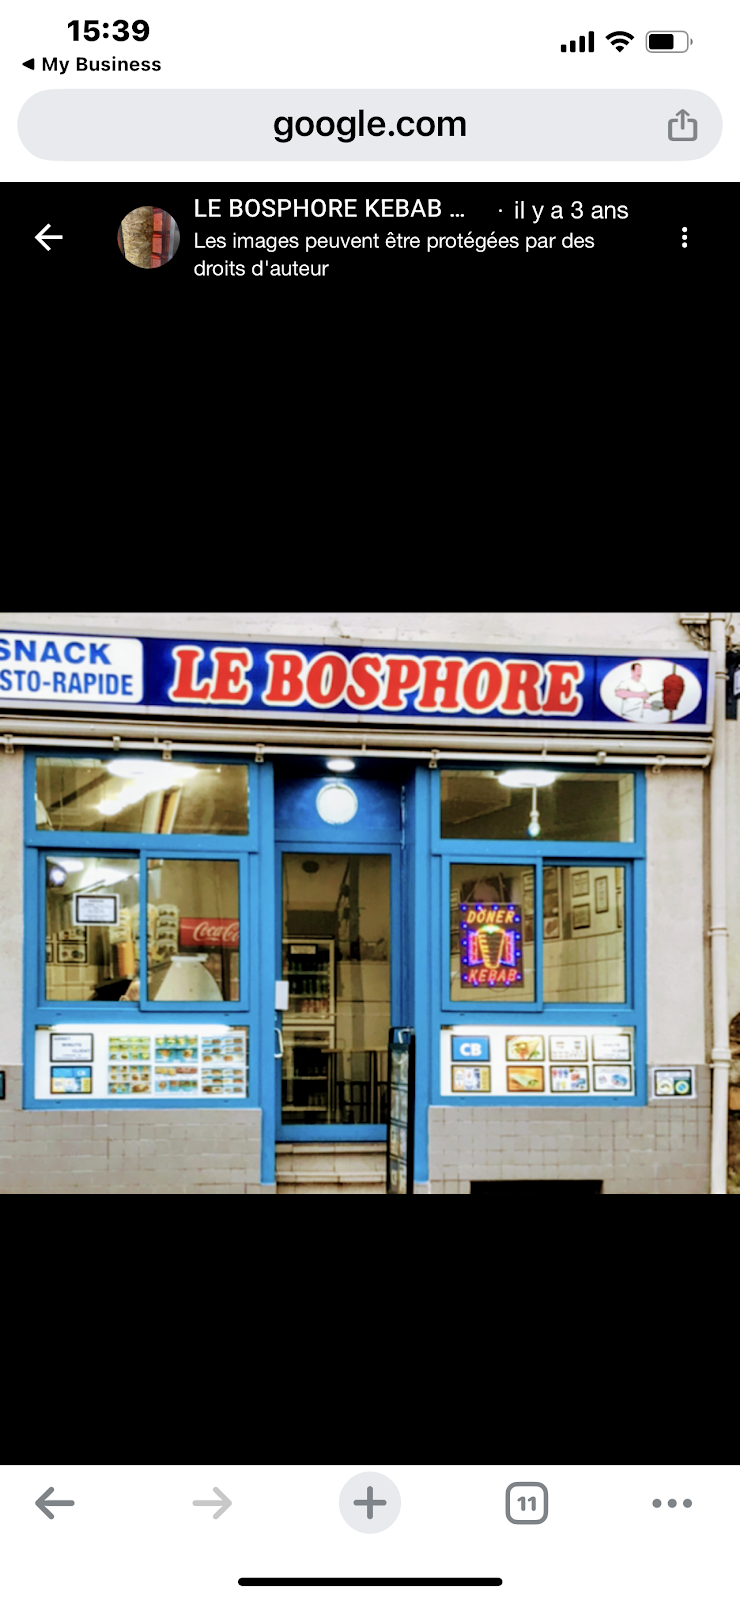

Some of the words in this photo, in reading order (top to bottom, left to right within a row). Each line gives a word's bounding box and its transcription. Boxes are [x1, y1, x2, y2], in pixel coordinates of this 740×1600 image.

[0, 638, 112, 665] SNACK
[172, 648, 250, 703] LE
[264, 651, 583, 715] BOSPHORE
[468, 968, 518, 983] KEBAB
[459, 1042, 483, 1056] CB
